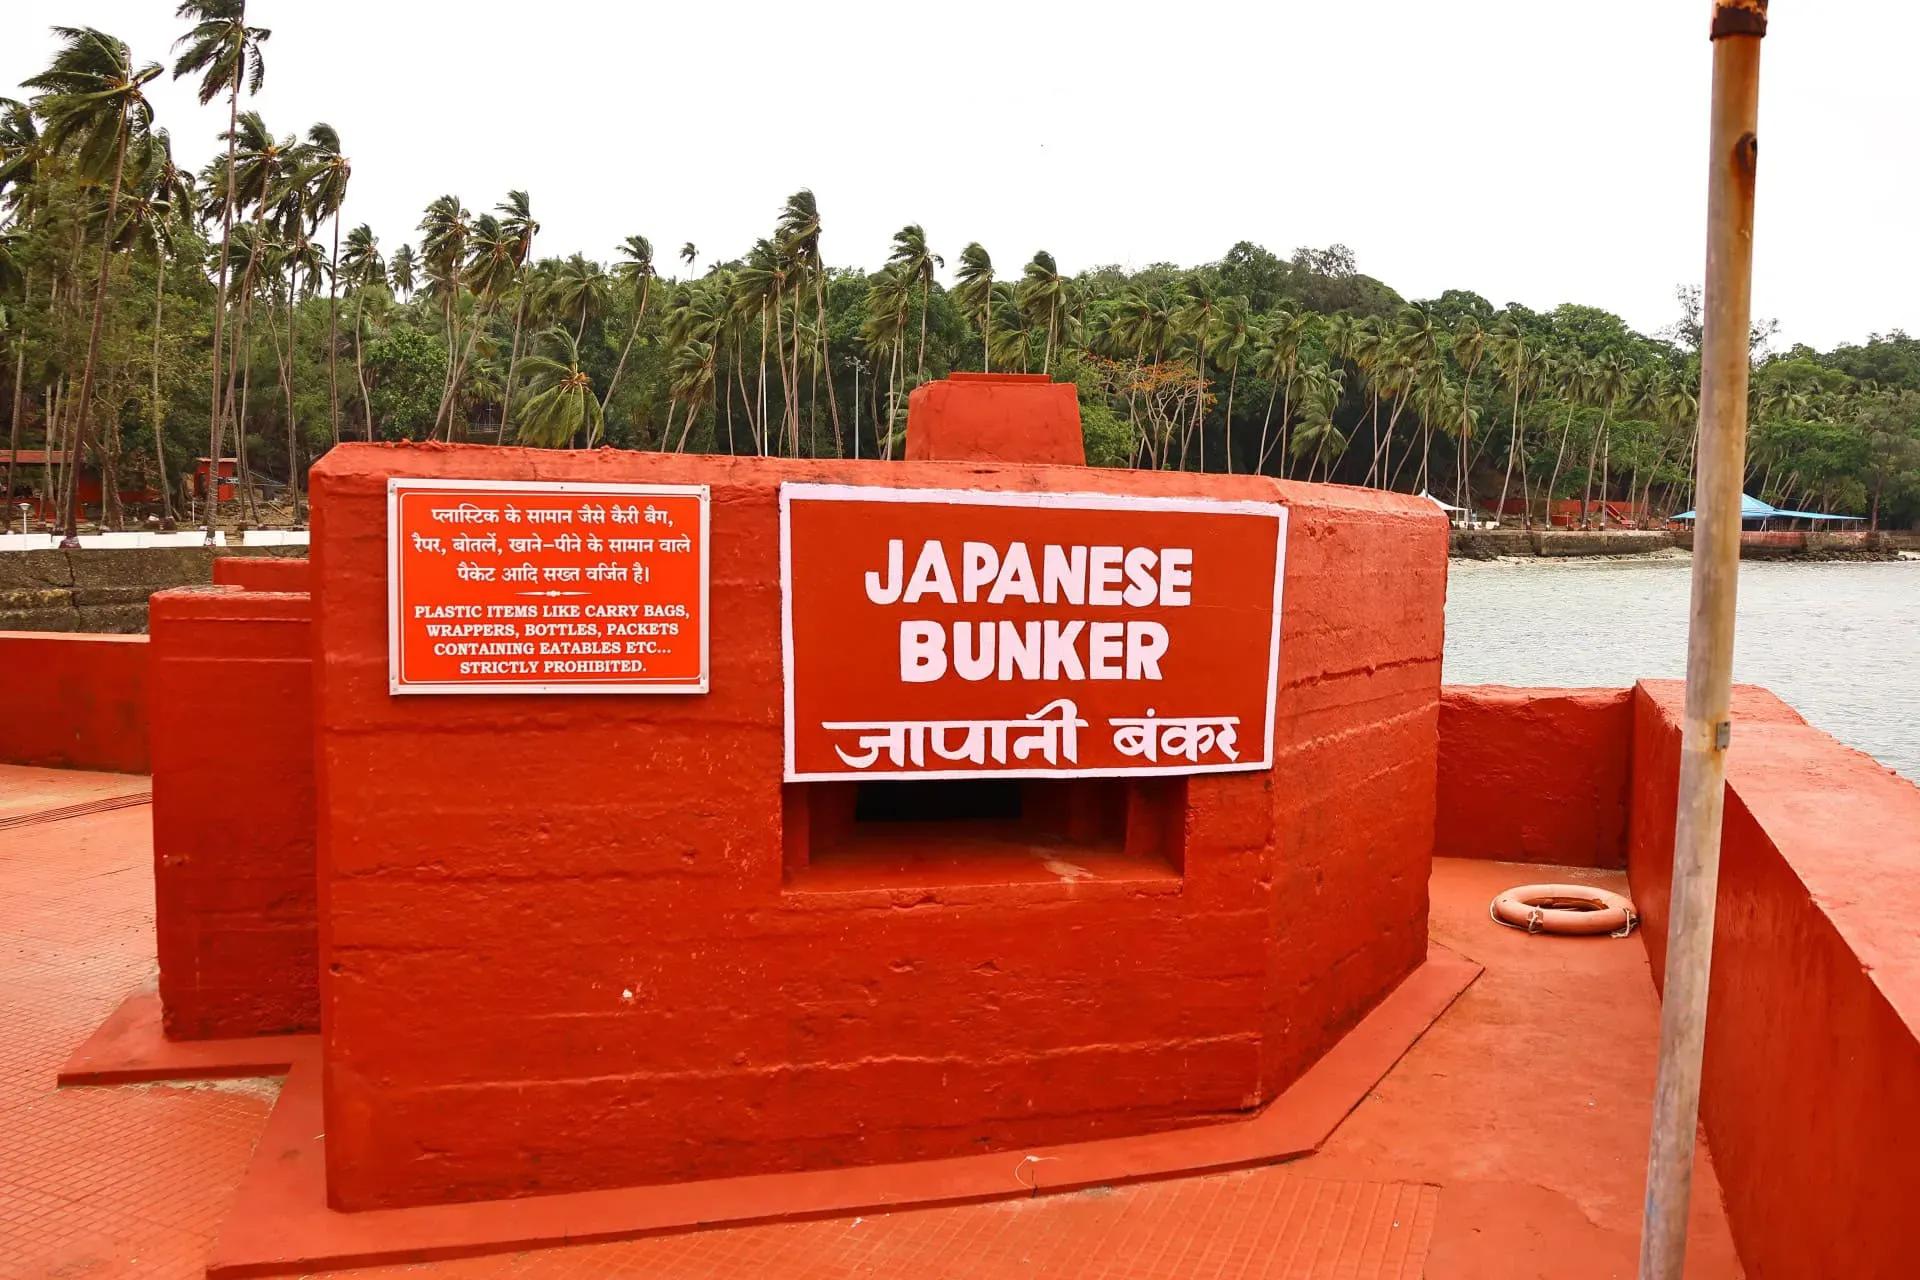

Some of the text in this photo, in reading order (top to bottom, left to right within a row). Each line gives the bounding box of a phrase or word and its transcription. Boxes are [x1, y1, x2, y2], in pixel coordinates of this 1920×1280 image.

[431, 503, 673, 527] प्लास्टिक के सामान जैसे कैरी बैग,
[411, 532, 446, 554] रैपर,
[452, 532, 503, 555] बोतलें,
[586, 533, 602, 552] के
[608, 538, 654, 552] सामान
[659, 533, 691, 552] वाले
[457, 561, 496, 582] पैकेट
[502, 562, 537, 584] आदि
[543, 567, 580, 582] सख्त
[586, 561, 627, 582] वर्जित
[865, 539, 1193, 607] JAPANESE
[415, 605, 690, 619] PLASTIC ITEMS LIKE CARRY BAGS,
[426, 623, 679, 638] WRAPPERS, BOTTLES, PACKETS
[434, 642, 535, 655] CONTAINING
[540, 642, 621, 655] EATABLES
[900, 620, 1170, 683] BUNKER
[459, 660, 647, 674] STRICTLY PROHIBITED.
[822, 698, 1241, 768] जापानी बंकर
